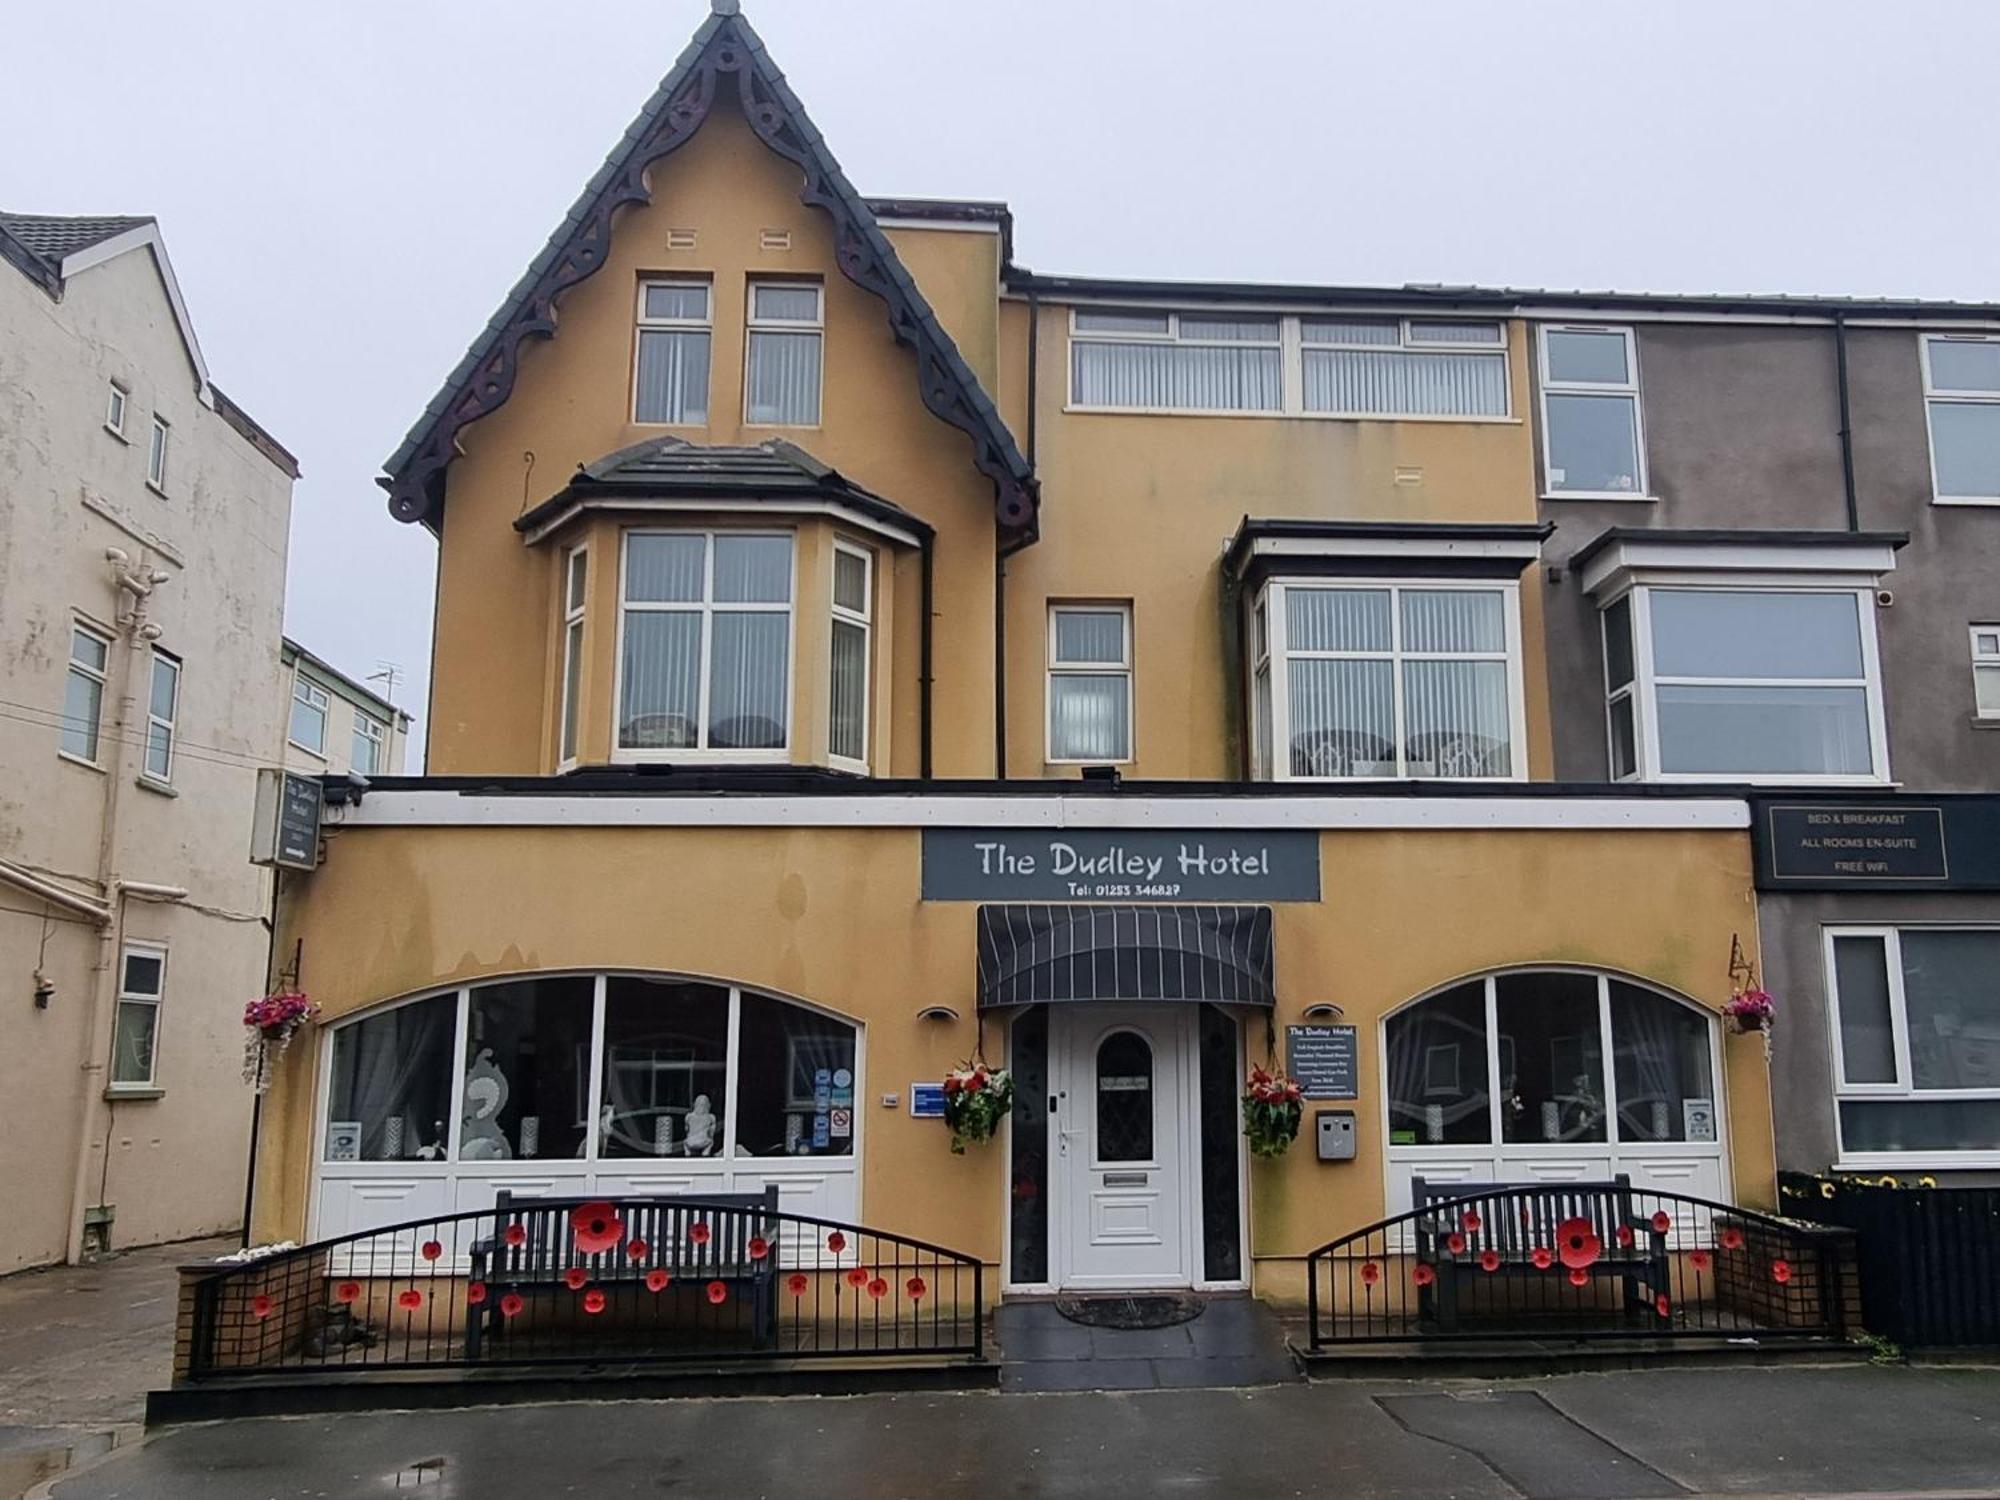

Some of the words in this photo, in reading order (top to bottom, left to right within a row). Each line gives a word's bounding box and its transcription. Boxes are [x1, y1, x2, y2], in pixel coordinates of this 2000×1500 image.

[1807, 814, 1831, 824] BED
[1833, 814, 1841, 824] &
[1843, 814, 1906, 825] BREAKFAST
[1801, 838, 1820, 848] ALL
[1823, 838, 1864, 848] ROOMS
[975, 842, 1036, 875] The
[1050, 842, 1163, 880] Dudley
[1178, 843, 1269, 876] Hotel
[1834, 861, 1864, 872] FREE
[1068, 882, 1092, 897] Tel:
[1095, 884, 1130, 896] 01253
